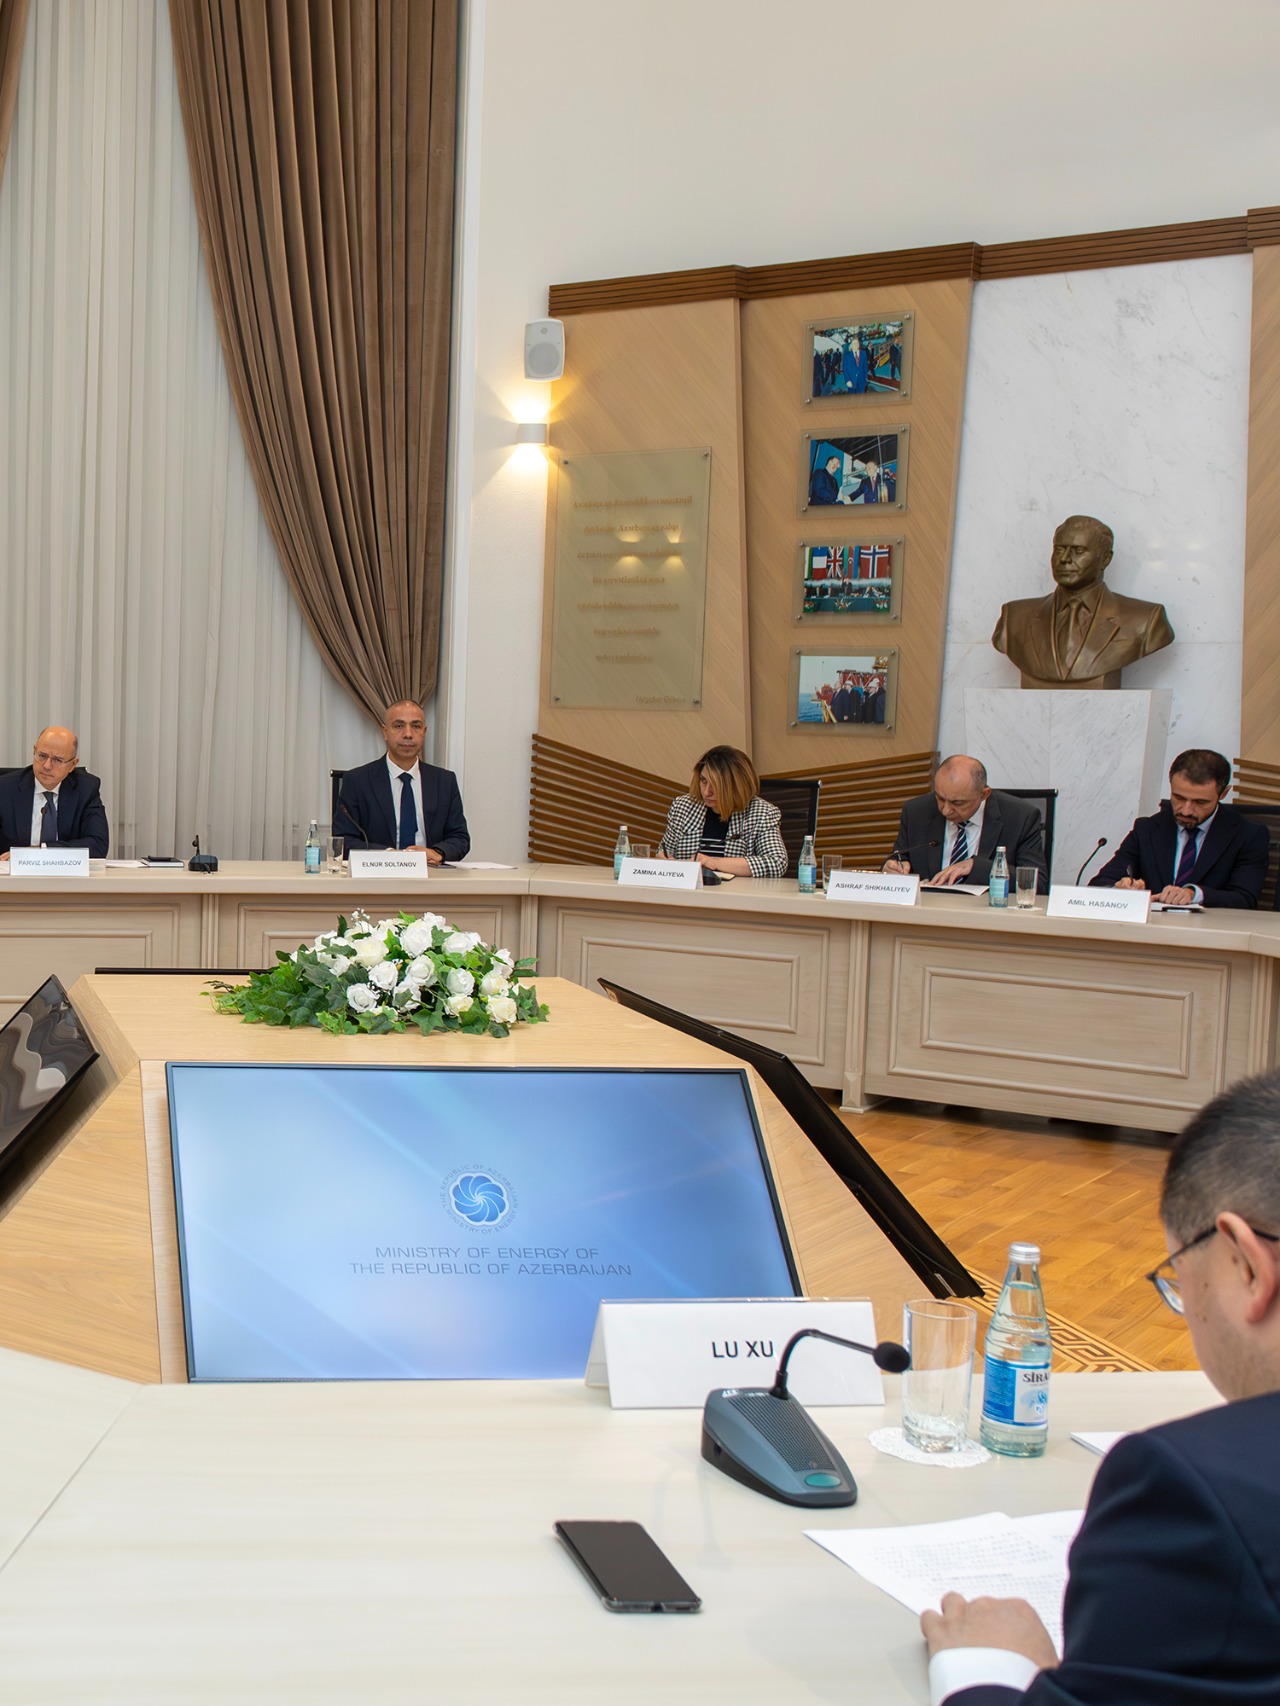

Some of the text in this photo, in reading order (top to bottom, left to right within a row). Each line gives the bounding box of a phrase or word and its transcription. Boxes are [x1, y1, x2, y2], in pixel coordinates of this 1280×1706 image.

[632, 868, 657, 876] ZAMINA
[835, 882, 911, 893] ASHRAF SHIKHALIYEV
[1067, 899, 1129, 909] AMIL HASANOV
[375, 1247, 600, 1260] MINISTRY OF ENERGY OF
[349, 1262, 632, 1277] THE REPUBLIC OF AZERBAIJAN
[711, 1340, 774, 1359] LU XU
